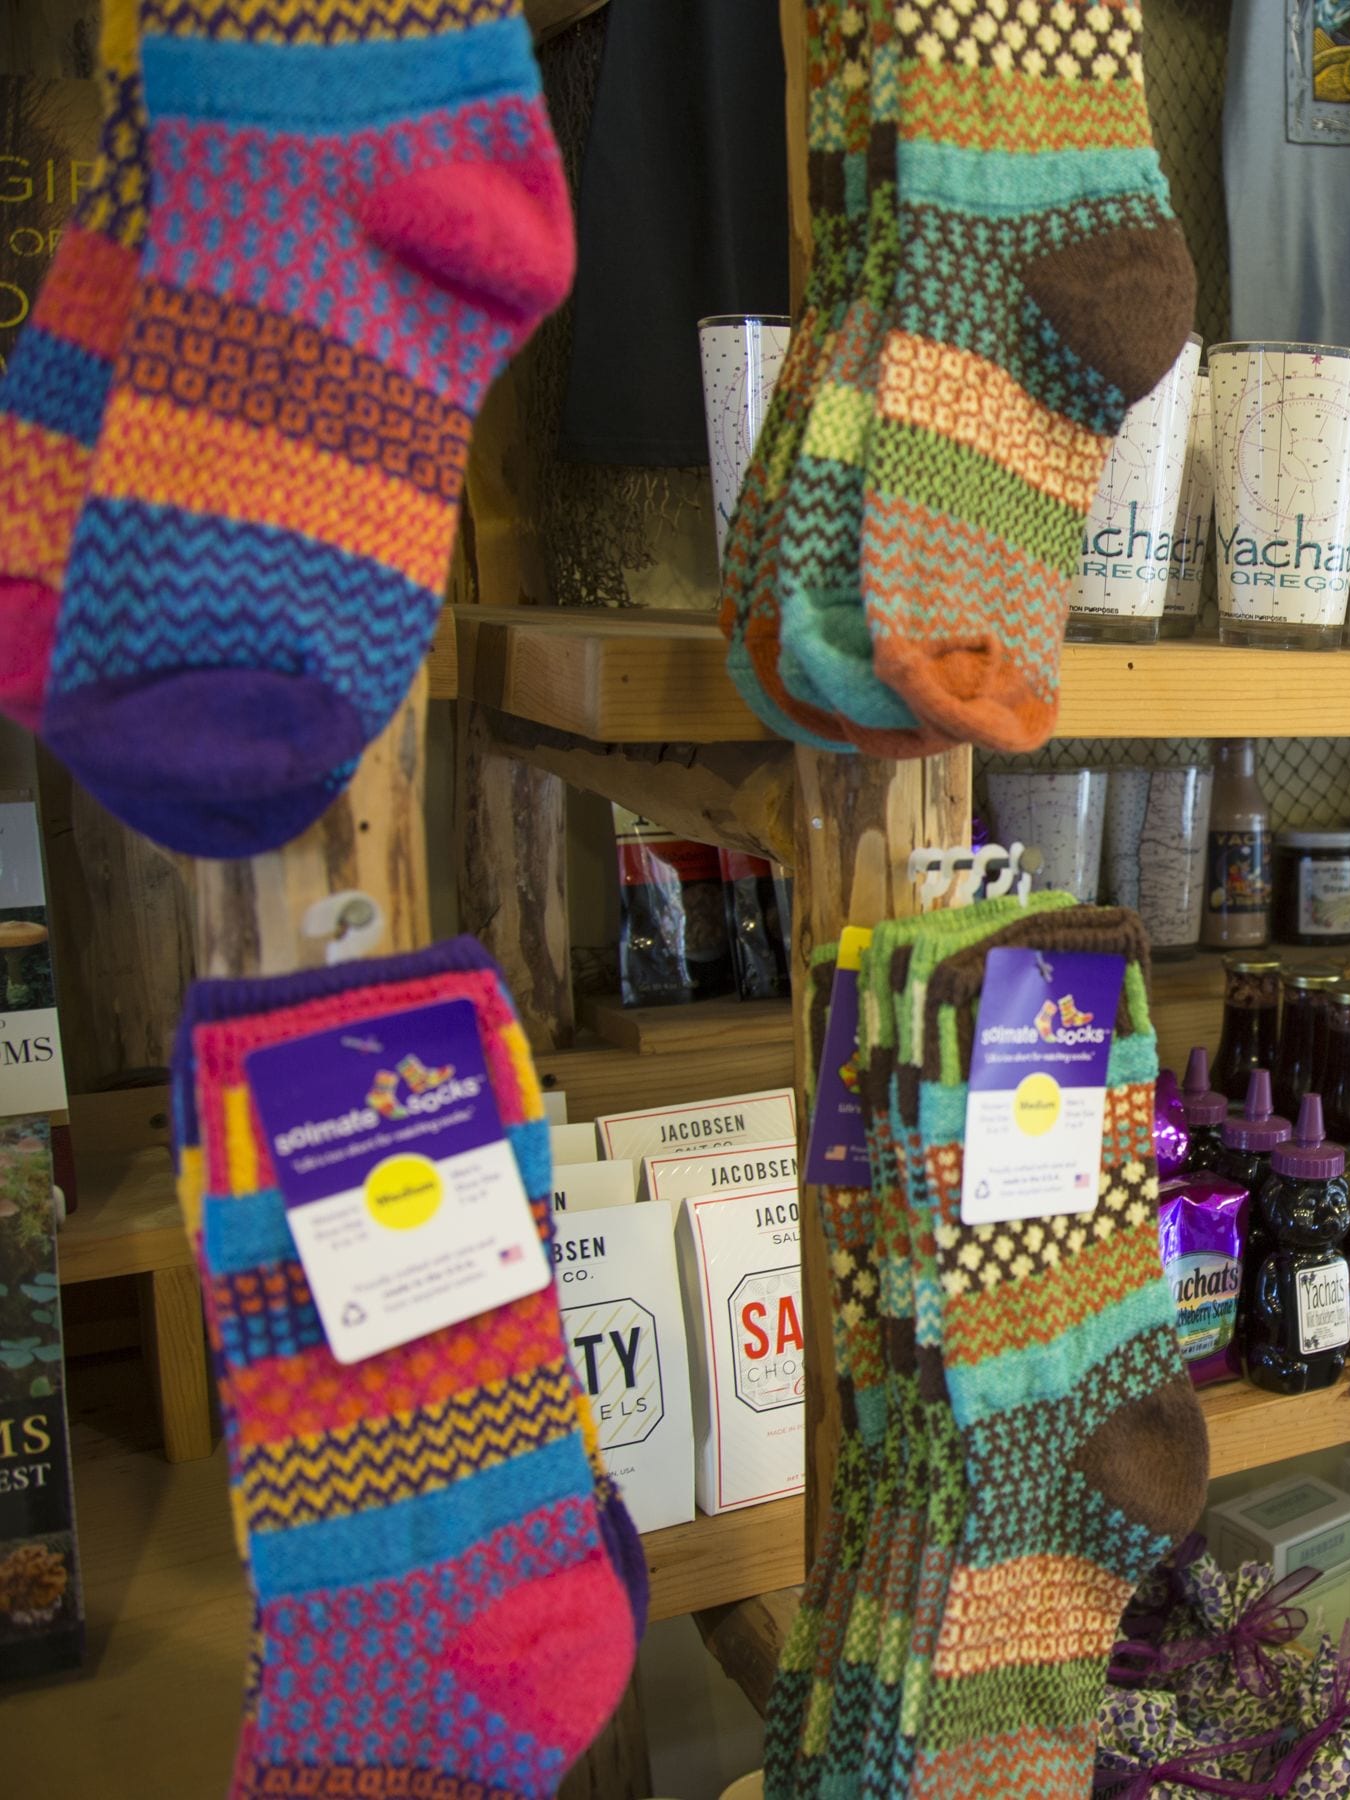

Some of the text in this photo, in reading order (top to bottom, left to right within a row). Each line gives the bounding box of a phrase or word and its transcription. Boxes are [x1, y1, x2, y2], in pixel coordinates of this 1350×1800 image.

[660, 1114, 746, 1144] JACOBSEN
[756, 1202, 800, 1228] JACO
[552, 1235, 607, 1264] BSEN
[562, 1268, 595, 1284] CO.
[1172, 1261, 1240, 1303] achats
[1302, 1272, 1346, 1311] Yachats
[741, 1294, 805, 1361] SA
[573, 1326, 641, 1396] TY
[600, 1397, 648, 1421] ELS
